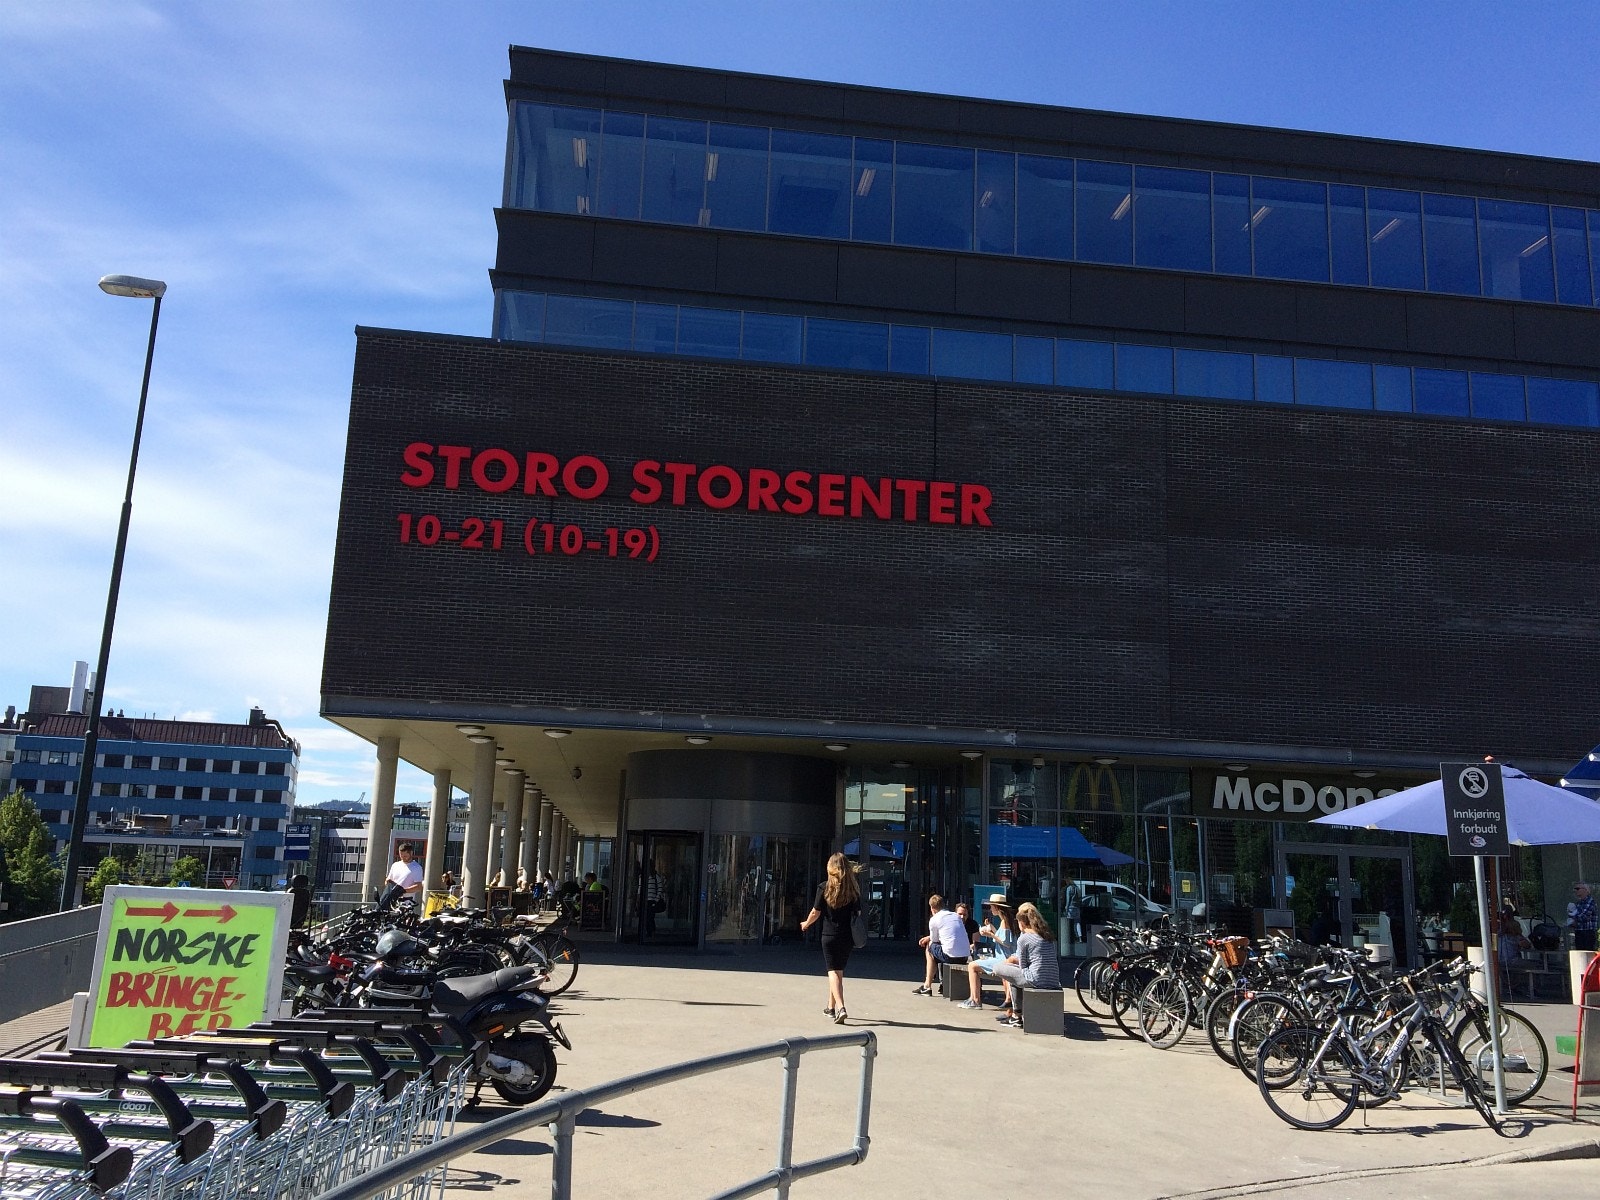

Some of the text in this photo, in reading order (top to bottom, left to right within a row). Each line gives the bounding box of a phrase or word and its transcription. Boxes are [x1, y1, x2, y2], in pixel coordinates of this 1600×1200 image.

[400, 442, 994, 527] STORO STORSENTER
[397, 513, 660, 563] 10-21 (10-19)
[1213, 776, 1413, 815] McDon
[1453, 808, 1501, 821] Innkjøring
[1460, 823, 1498, 834] forbudt
[112, 927, 260, 969] NORSKE
[105, 966, 246, 1013] BRINGE-
